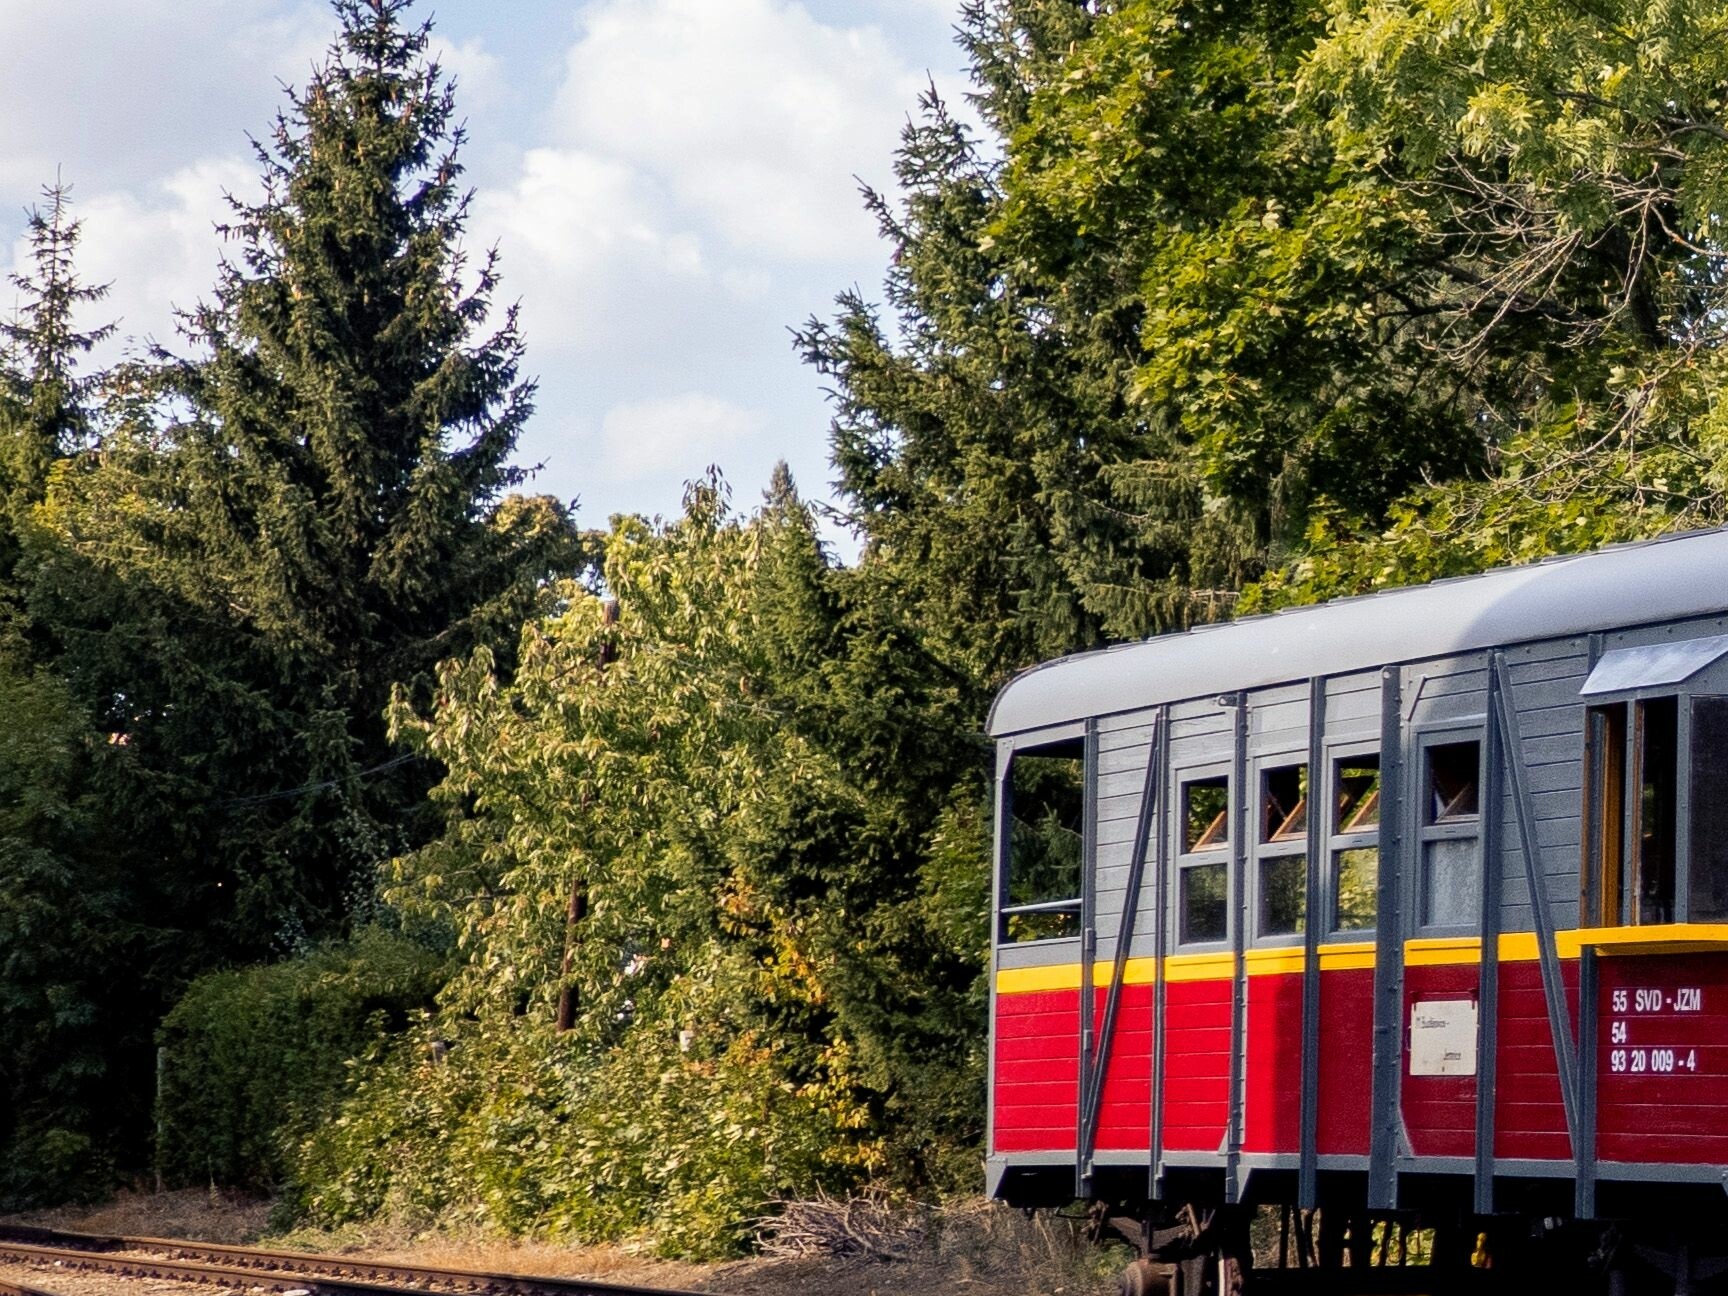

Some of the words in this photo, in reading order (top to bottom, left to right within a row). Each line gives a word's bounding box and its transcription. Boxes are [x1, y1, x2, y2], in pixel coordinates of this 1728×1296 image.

[1612, 990, 1627, 1012] 55
[1611, 1021, 1626, 1044] 54
[1611, 1049, 1626, 1072] 93
[1630, 1049, 1646, 1072] 20
